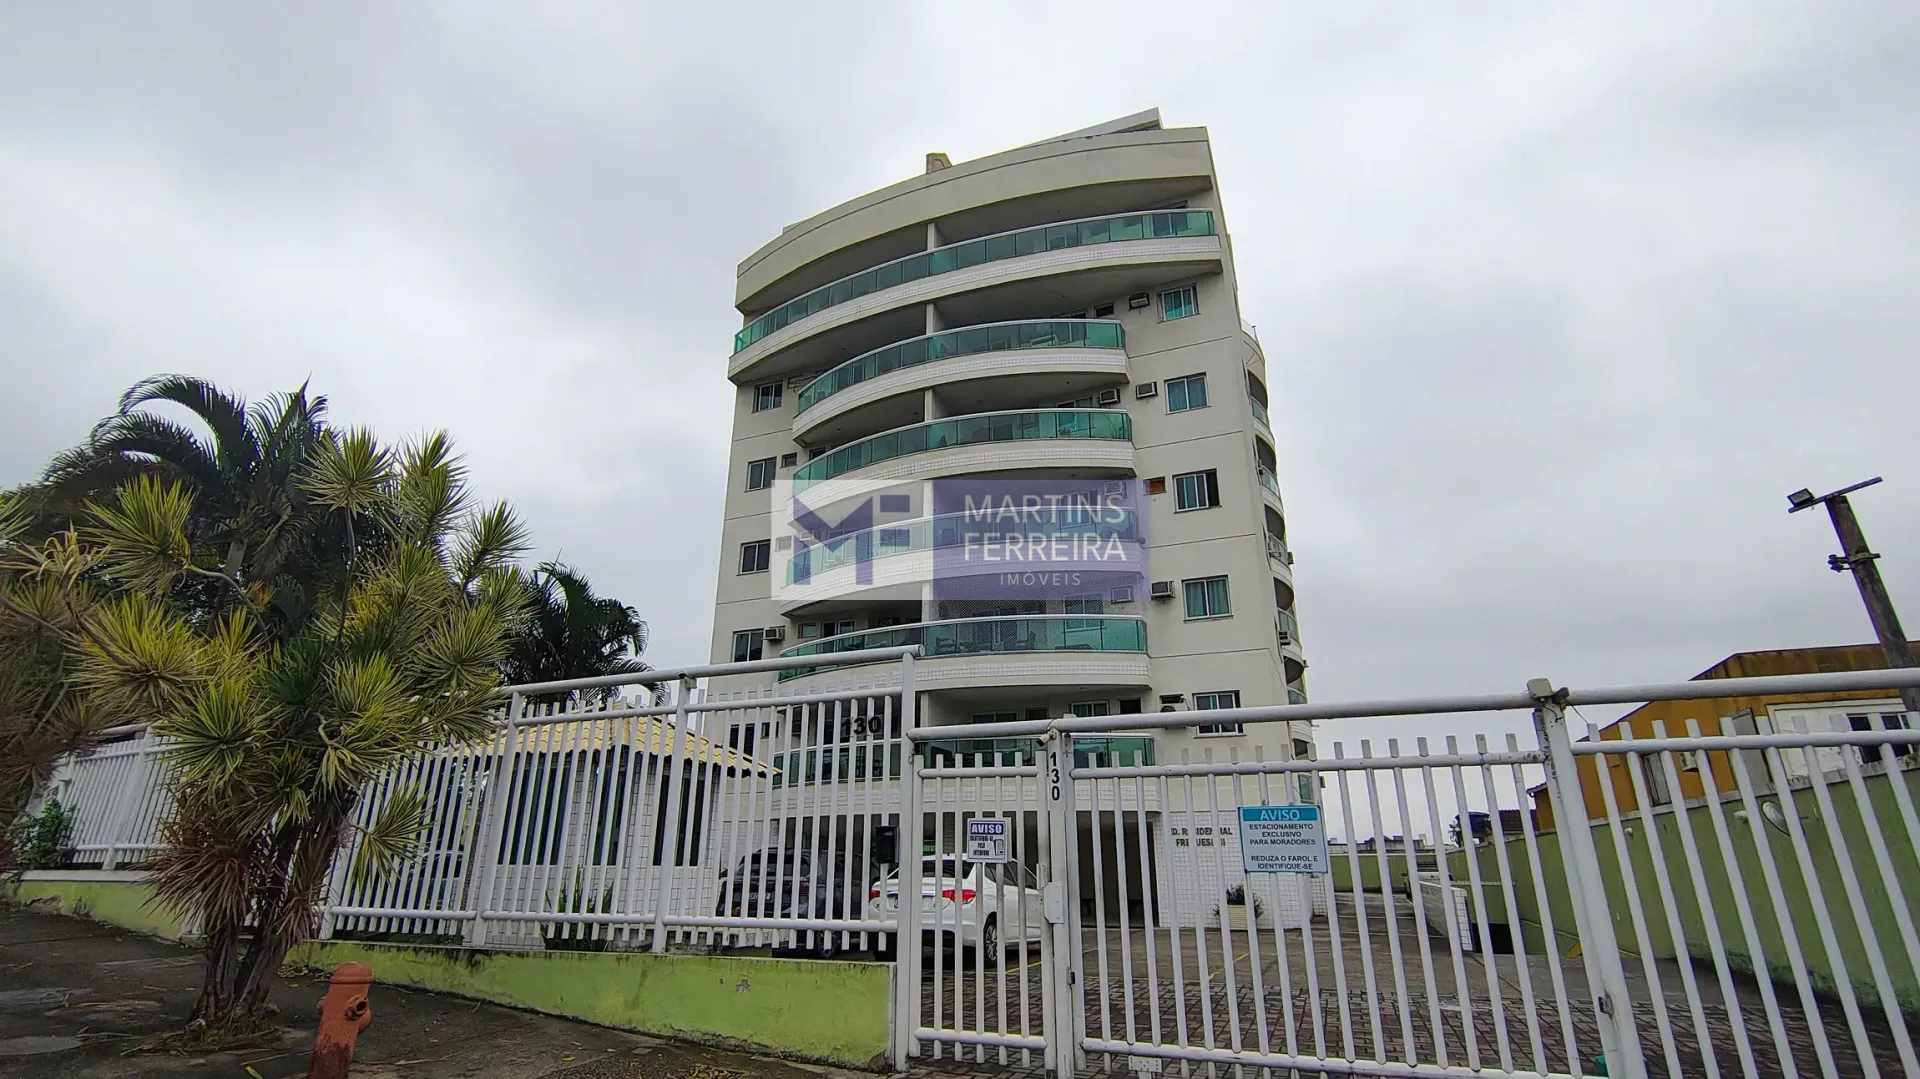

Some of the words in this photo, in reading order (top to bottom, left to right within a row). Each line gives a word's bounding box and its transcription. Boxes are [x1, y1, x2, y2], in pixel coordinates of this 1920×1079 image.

[841, 716, 881, 736] 130
[1050, 751, 1060, 801] 130
[1260, 809, 1300, 820] AVISO
[971, 824, 1002, 834] AVISO
